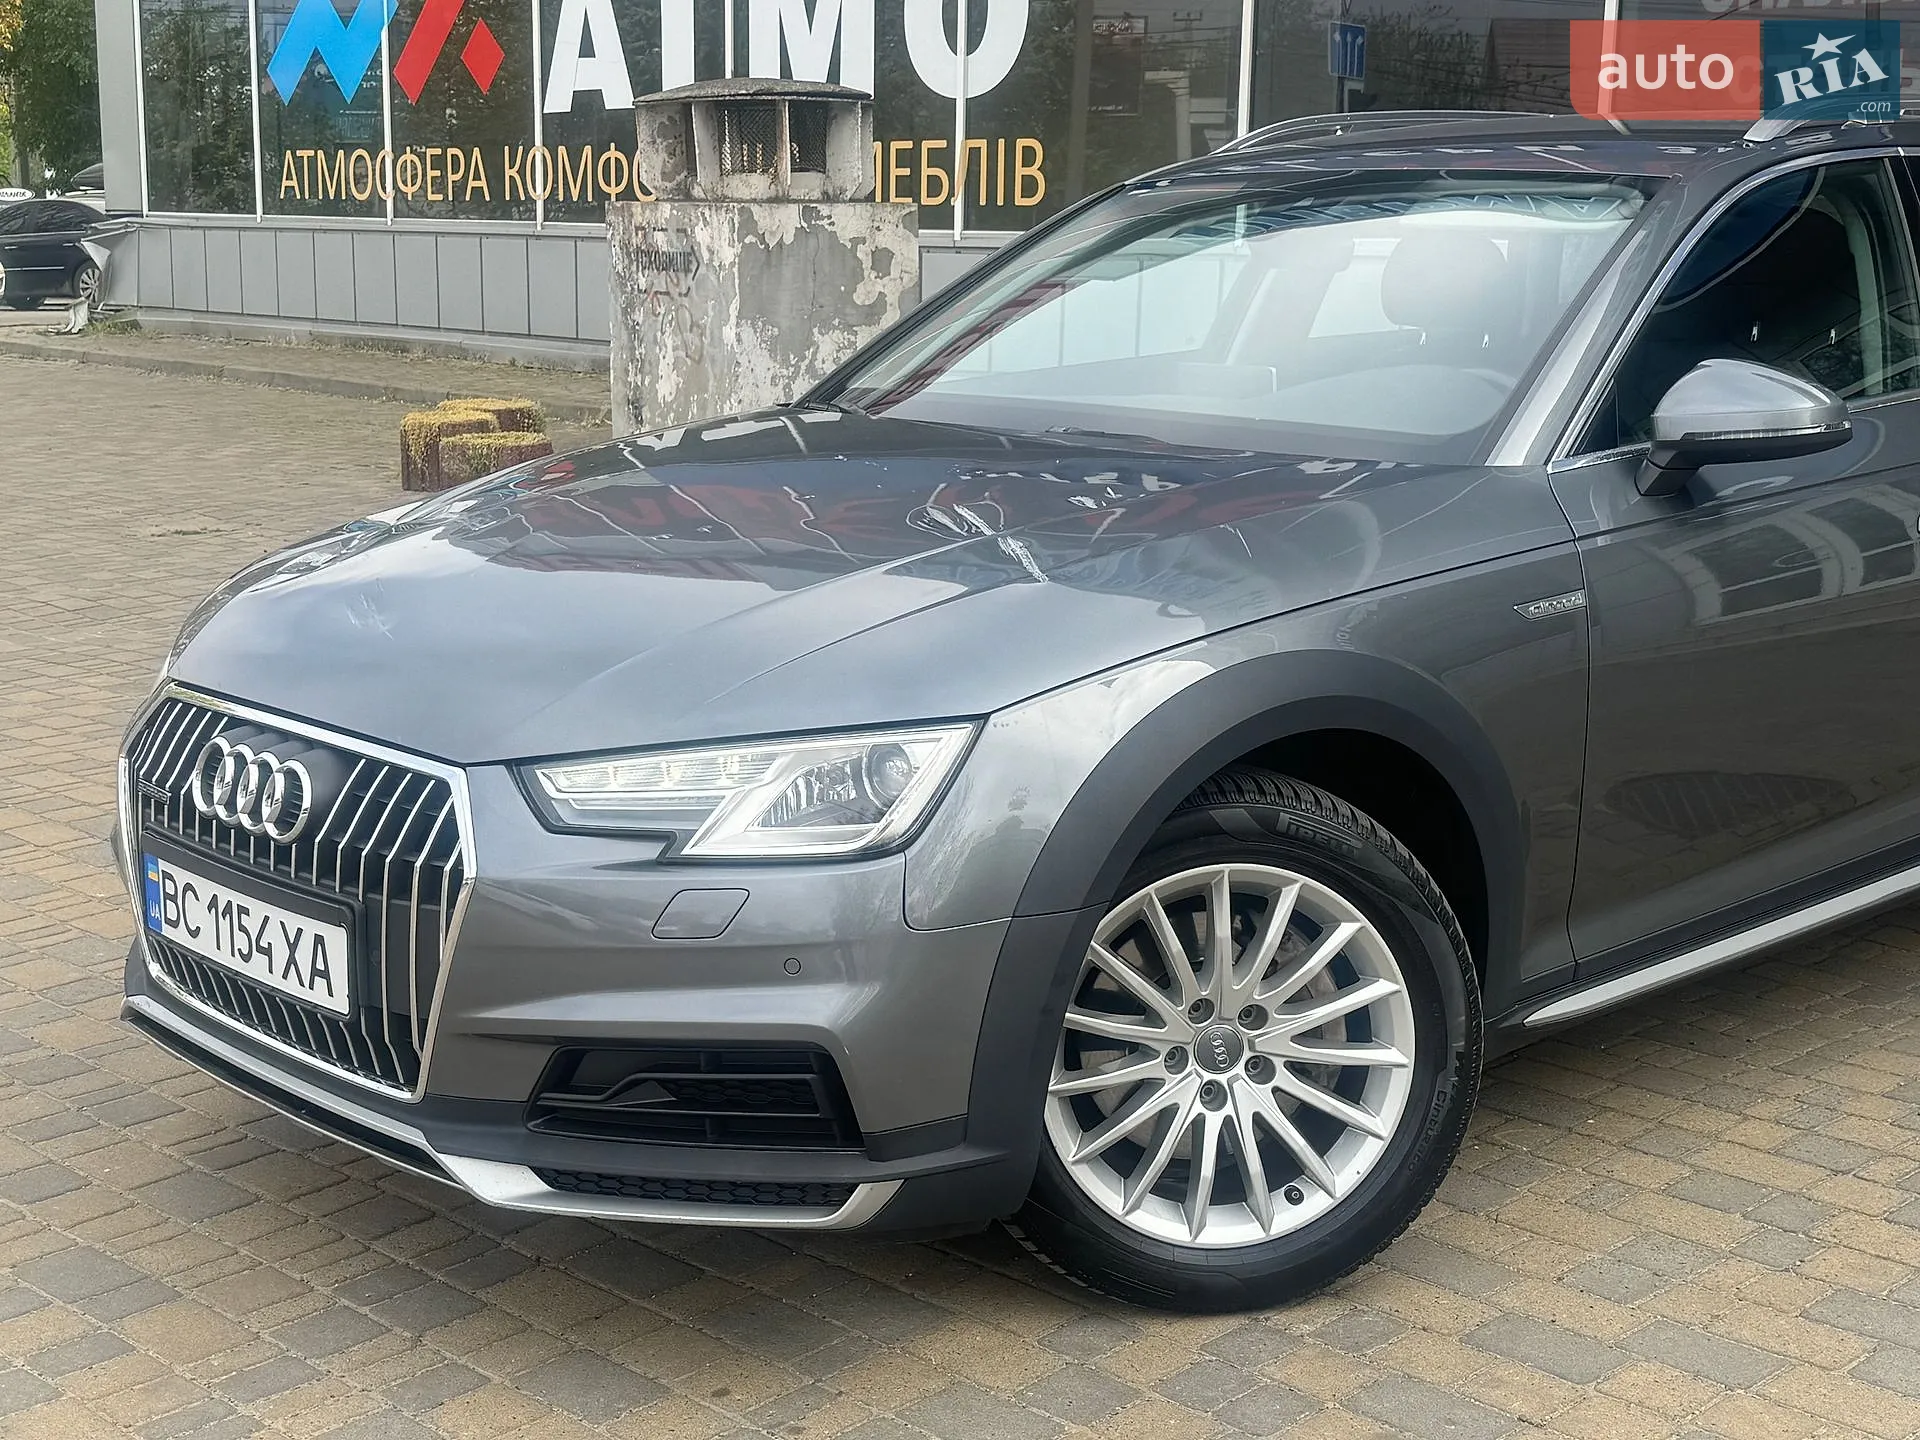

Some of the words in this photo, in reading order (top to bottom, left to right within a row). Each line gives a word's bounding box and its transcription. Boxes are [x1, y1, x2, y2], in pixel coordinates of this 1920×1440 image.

[279, 146, 491, 201] АТМОСФЕРА
[150, 902, 161, 921] UA
[161, 869, 201, 939] BC
[207, 893, 273, 975] 1154
[279, 919, 334, 998] XA
